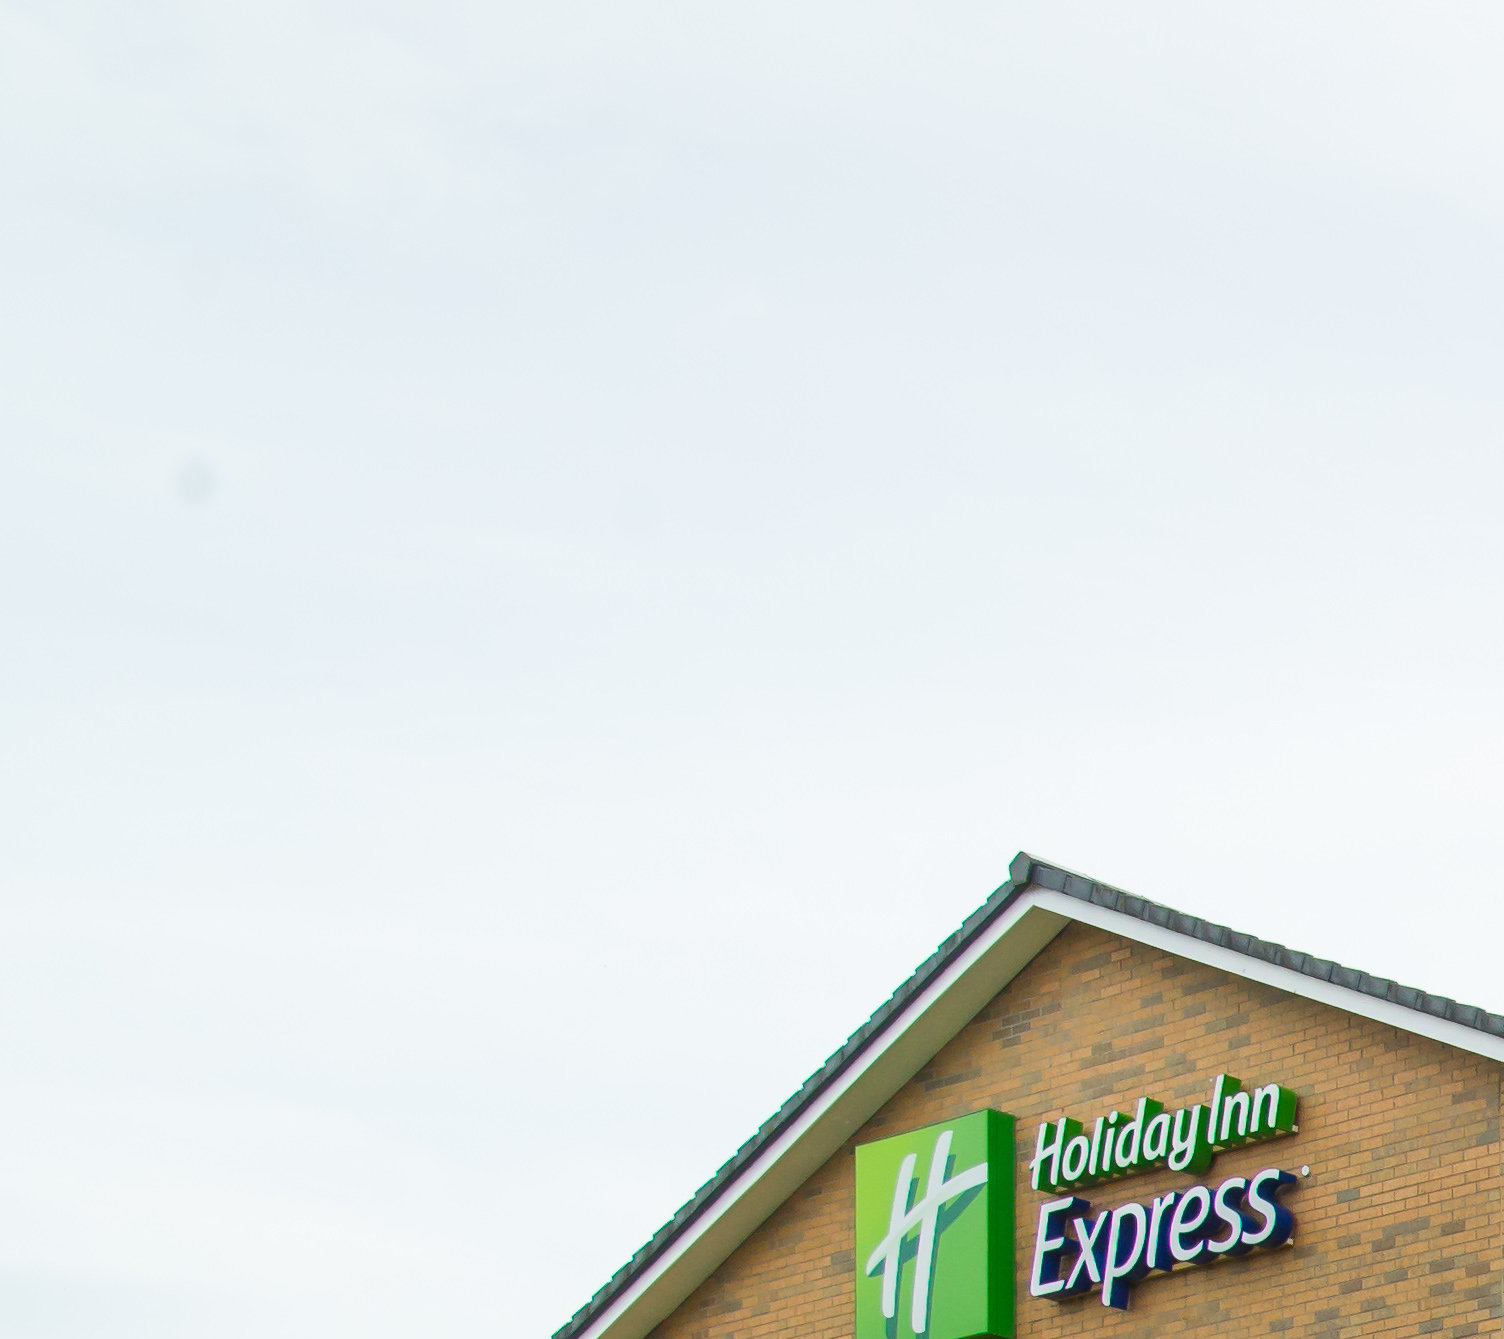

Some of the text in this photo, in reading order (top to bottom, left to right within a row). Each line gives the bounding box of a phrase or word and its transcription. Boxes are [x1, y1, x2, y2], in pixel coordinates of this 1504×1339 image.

[1029, 1073, 1280, 1191] Holiday Inn
[1030, 1168, 1281, 1307] Express
